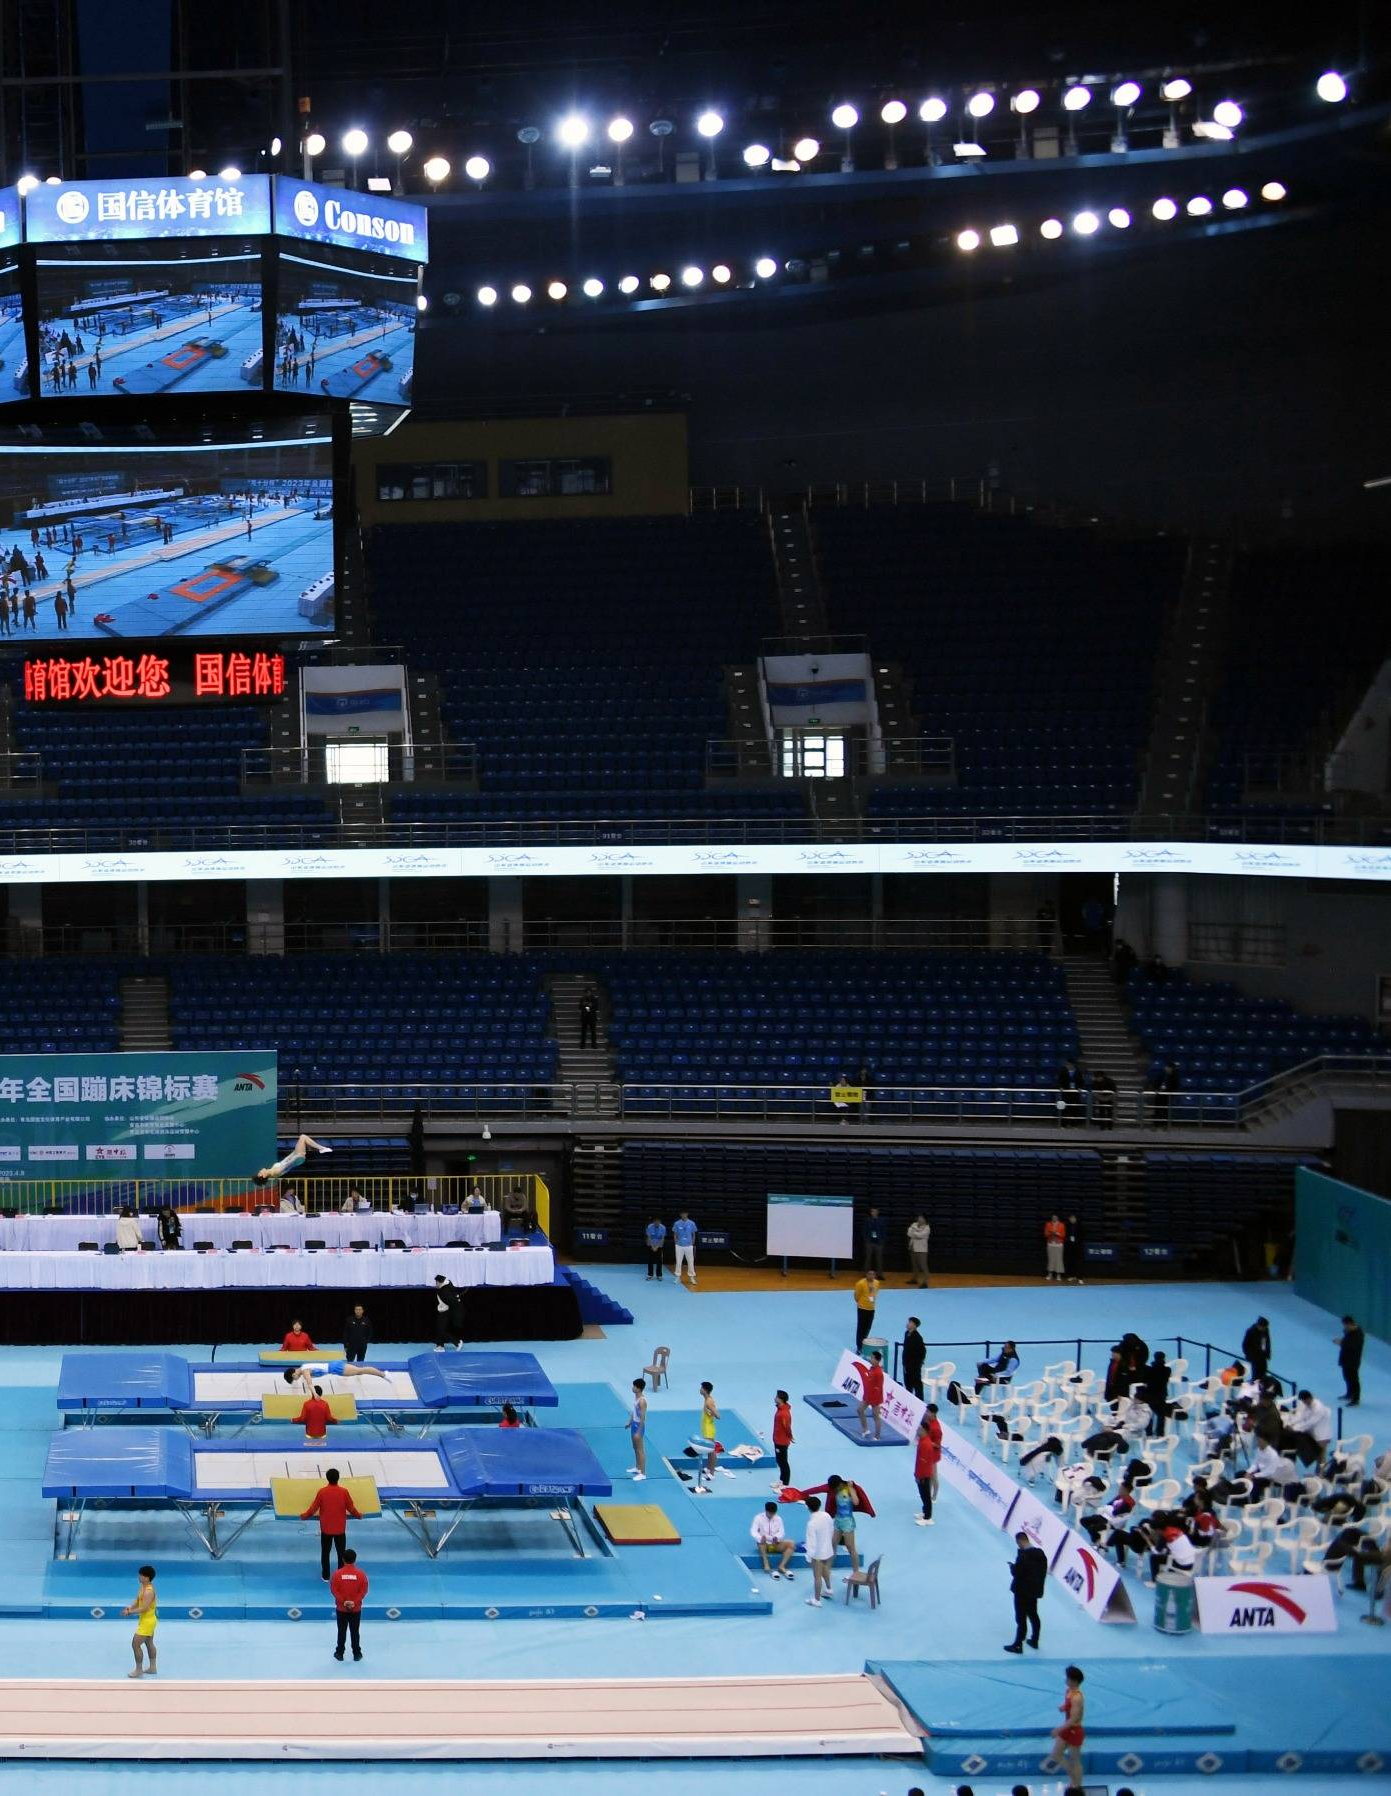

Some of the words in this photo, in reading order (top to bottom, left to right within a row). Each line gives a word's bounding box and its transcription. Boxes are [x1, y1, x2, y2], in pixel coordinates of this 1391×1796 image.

[97, 188, 244, 222] 国信体育馆
[324, 200, 416, 246] Conson
[195, 653, 284, 696] 国信体育
[234, 1083, 253, 1091] ANTA
[842, 1376, 860, 1394] ANTA
[1229, 1607, 1275, 1627] ANTA
